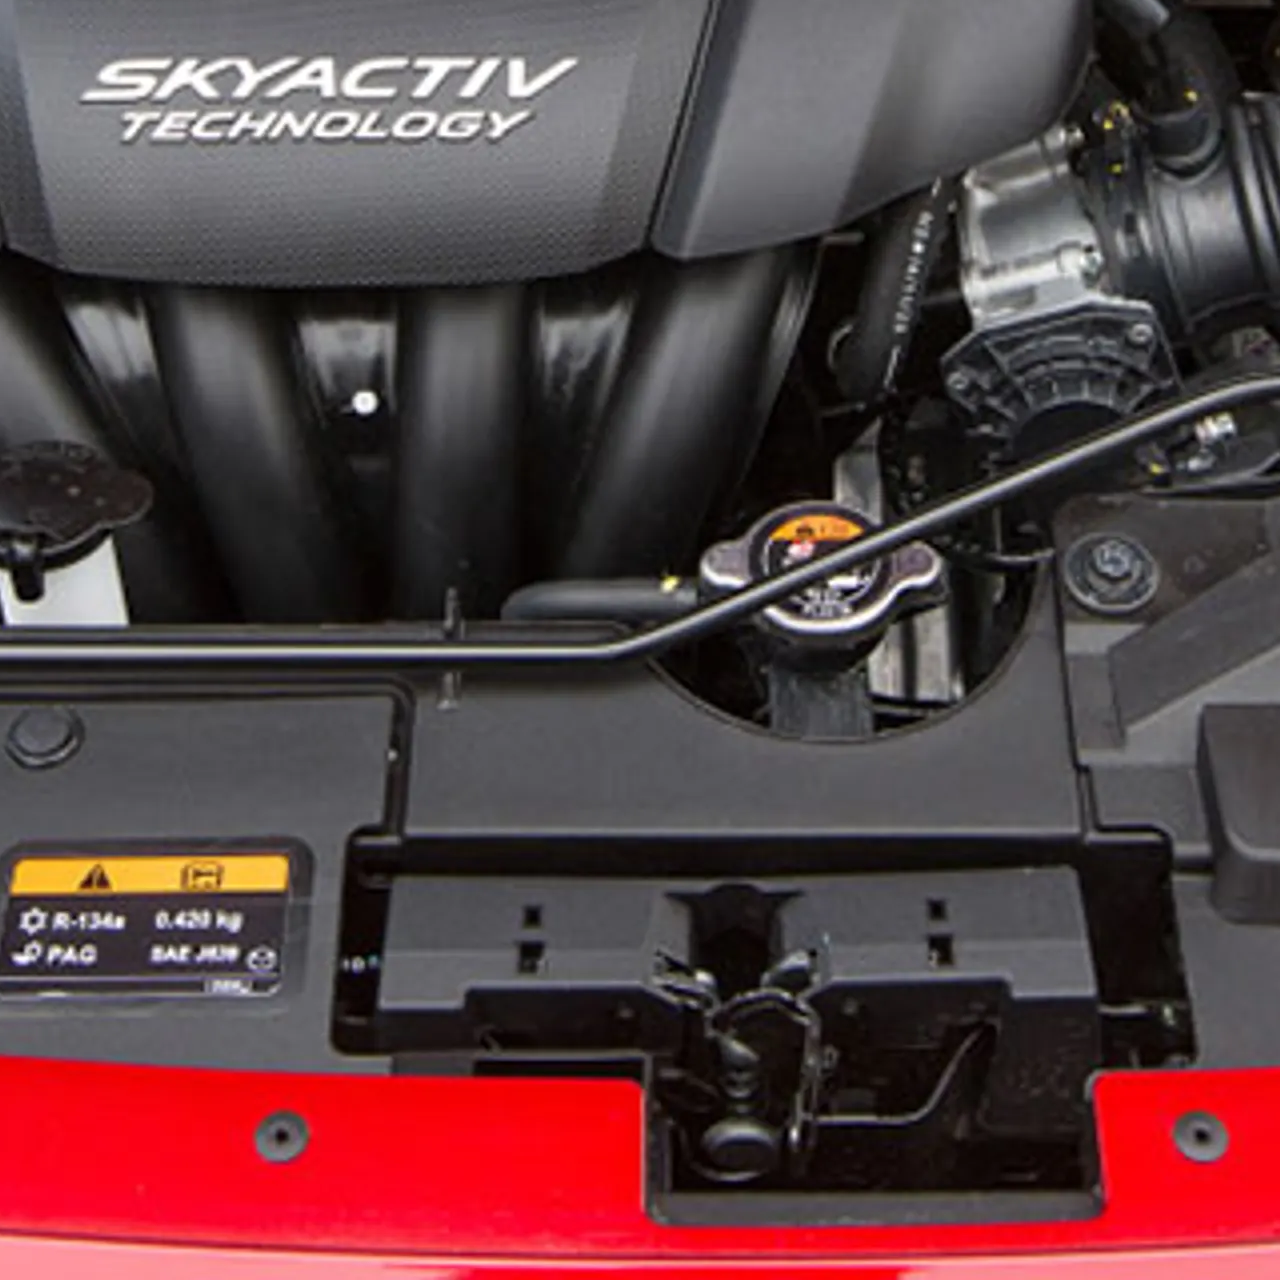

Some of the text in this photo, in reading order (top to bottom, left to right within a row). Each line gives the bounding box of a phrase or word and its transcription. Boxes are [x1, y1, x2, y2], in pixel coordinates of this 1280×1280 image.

[79, 56, 580, 102] SKYACTIV
[121, 109, 533, 141] TECHNOLOGY
[51, 910, 127, 932] R-134a
[214, 909, 244, 934] kg
[45, 943, 98, 966] PAG
